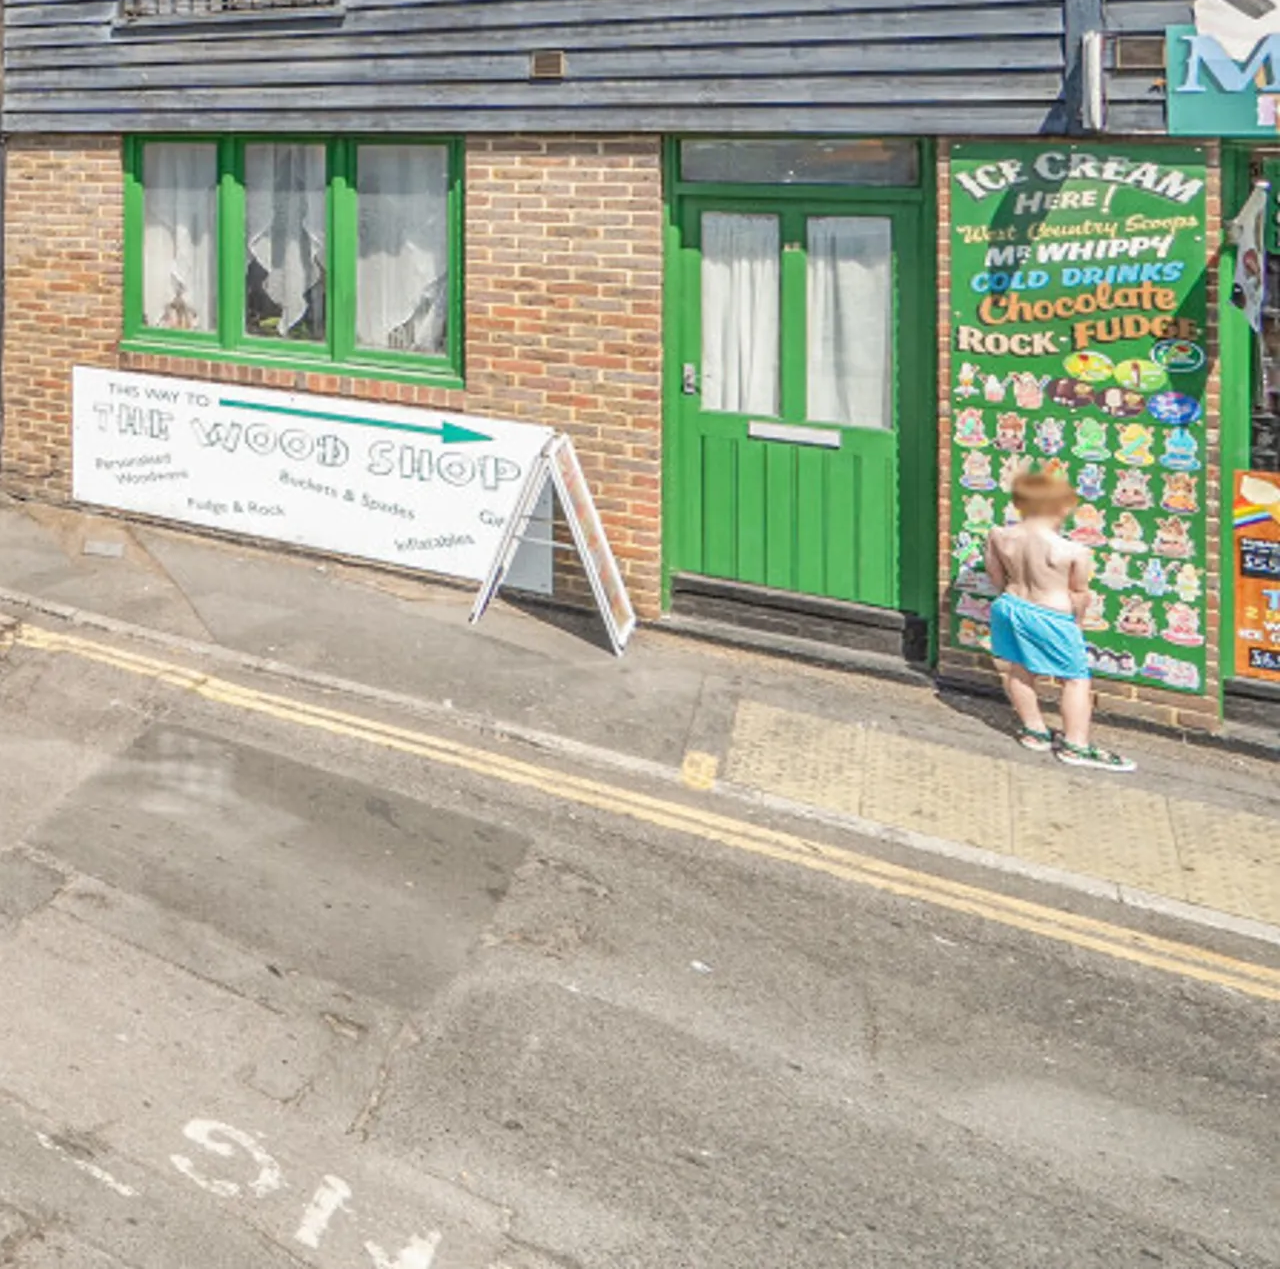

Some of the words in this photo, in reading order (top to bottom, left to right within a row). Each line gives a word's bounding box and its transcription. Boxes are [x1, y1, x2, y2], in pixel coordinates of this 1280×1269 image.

[955, 158, 1028, 204] ICE
[1033, 151, 1204, 205] CREAM
[956, 223, 1018, 244] West
[1027, 218, 1118, 241] Country
[1125, 213, 1200, 236] Scoops
[1036, 234, 1175, 264] WHIPPY
[970, 270, 1050, 293] COLD
[1061, 260, 1186, 287] DRINKS
[978, 280, 1179, 327] Chocolate
[957, 325, 1060, 356] ROCK
[1073, 314, 1198, 351] FUDGE
[109, 382, 140, 399] THIS
[144, 388, 180, 405] WAY
[185, 391, 210, 408] TO
[92, 402, 175, 442] THE
[189, 417, 350, 468] WOOD
[367, 440, 522, 491] SHOP
[187, 496, 229, 516] Fudge
[248, 500, 286, 517] Rock
[278, 469, 338, 499] Buckets
[342, 485, 356, 503] &
[361, 493, 416, 522] Spades
[393, 533, 476, 552] Inflatables
